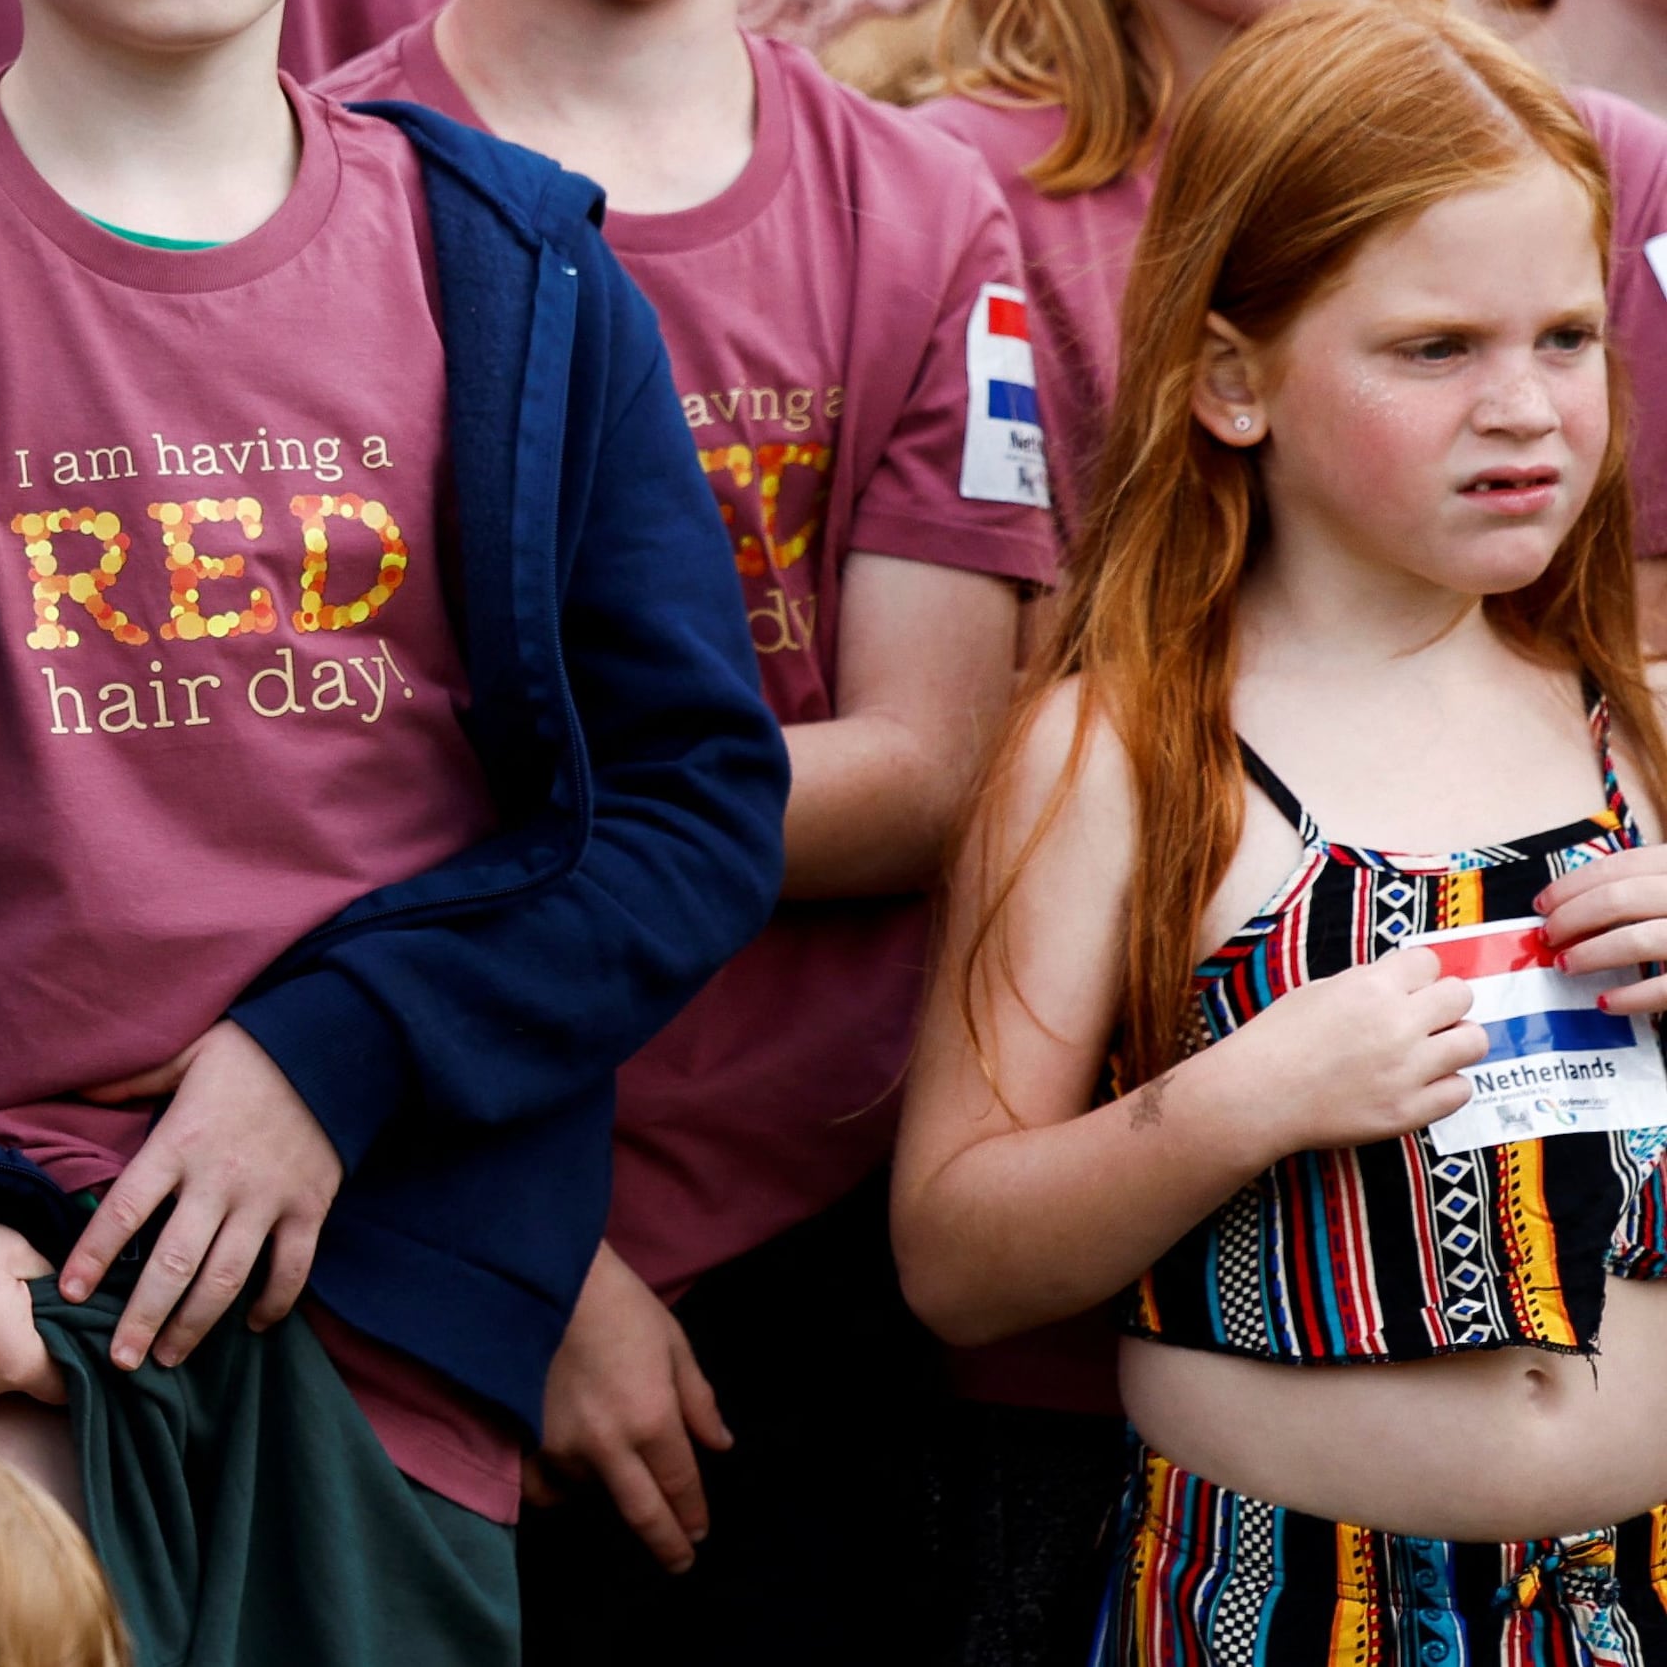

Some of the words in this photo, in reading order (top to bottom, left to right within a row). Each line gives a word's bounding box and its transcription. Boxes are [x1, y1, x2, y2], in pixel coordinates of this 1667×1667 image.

[15, 449, 33, 488] I
[53, 443, 139, 485] am
[152, 427, 344, 482] having
[362, 434, 393, 470] a
[10, 492, 408, 650] RED
[41, 660, 221, 735] hair
[247, 639, 414, 724] day!
[1474, 1056, 1616, 1094] Netherlands
